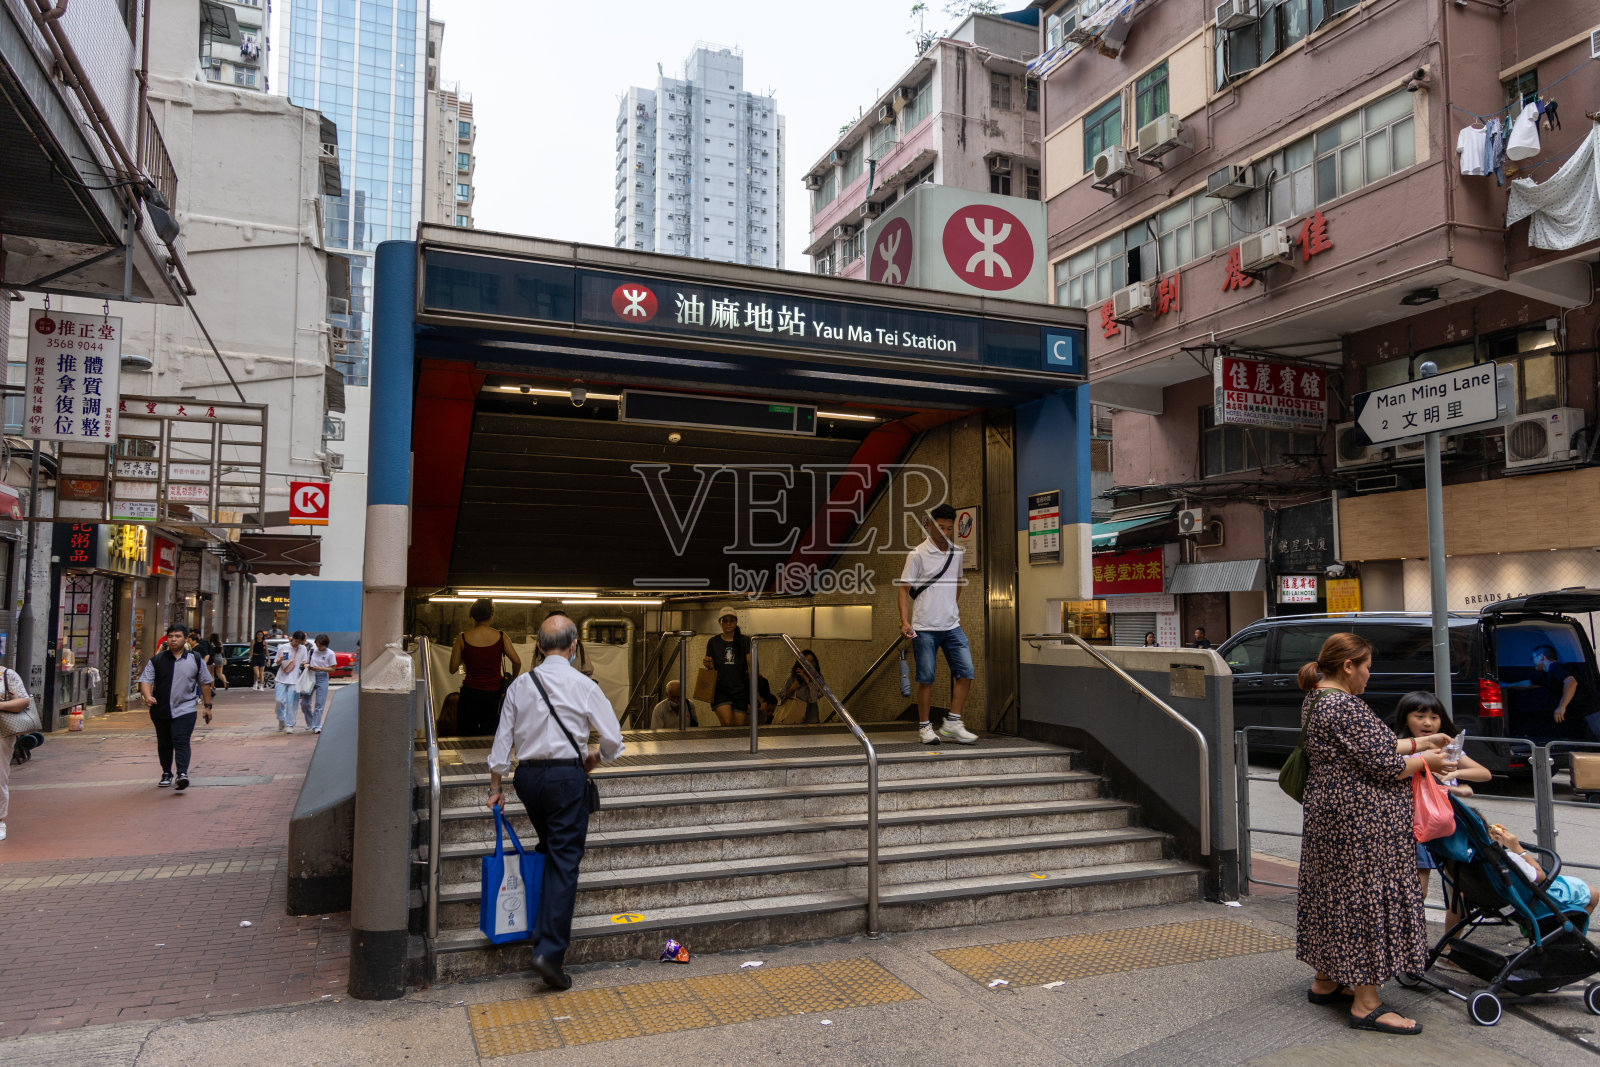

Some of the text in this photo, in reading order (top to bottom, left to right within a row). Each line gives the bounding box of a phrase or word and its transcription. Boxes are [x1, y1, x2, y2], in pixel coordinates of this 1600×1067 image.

[674, 291, 806, 337] 油麻地站
[46, 338, 104, 352] 3568 9044
[58, 319, 115, 341] 推正堂
[812, 320, 957, 352] Yau Ma Tei Station
[1053, 340, 1067, 361] C
[54, 353, 77, 435] 推拿復位
[1229, 361, 1321, 398] 佳麗賓館
[1377, 373, 1490, 409] Man Ming Lane
[81, 356, 104, 437] 體質調整
[1226, 391, 1248, 403] KEI
[1253, 394, 1273, 406] LAI
[1277, 397, 1325, 412] HOSTEL
[1381, 400, 1464, 430] 2 文明里
[1464, 593, 1502, 605] BREADS
